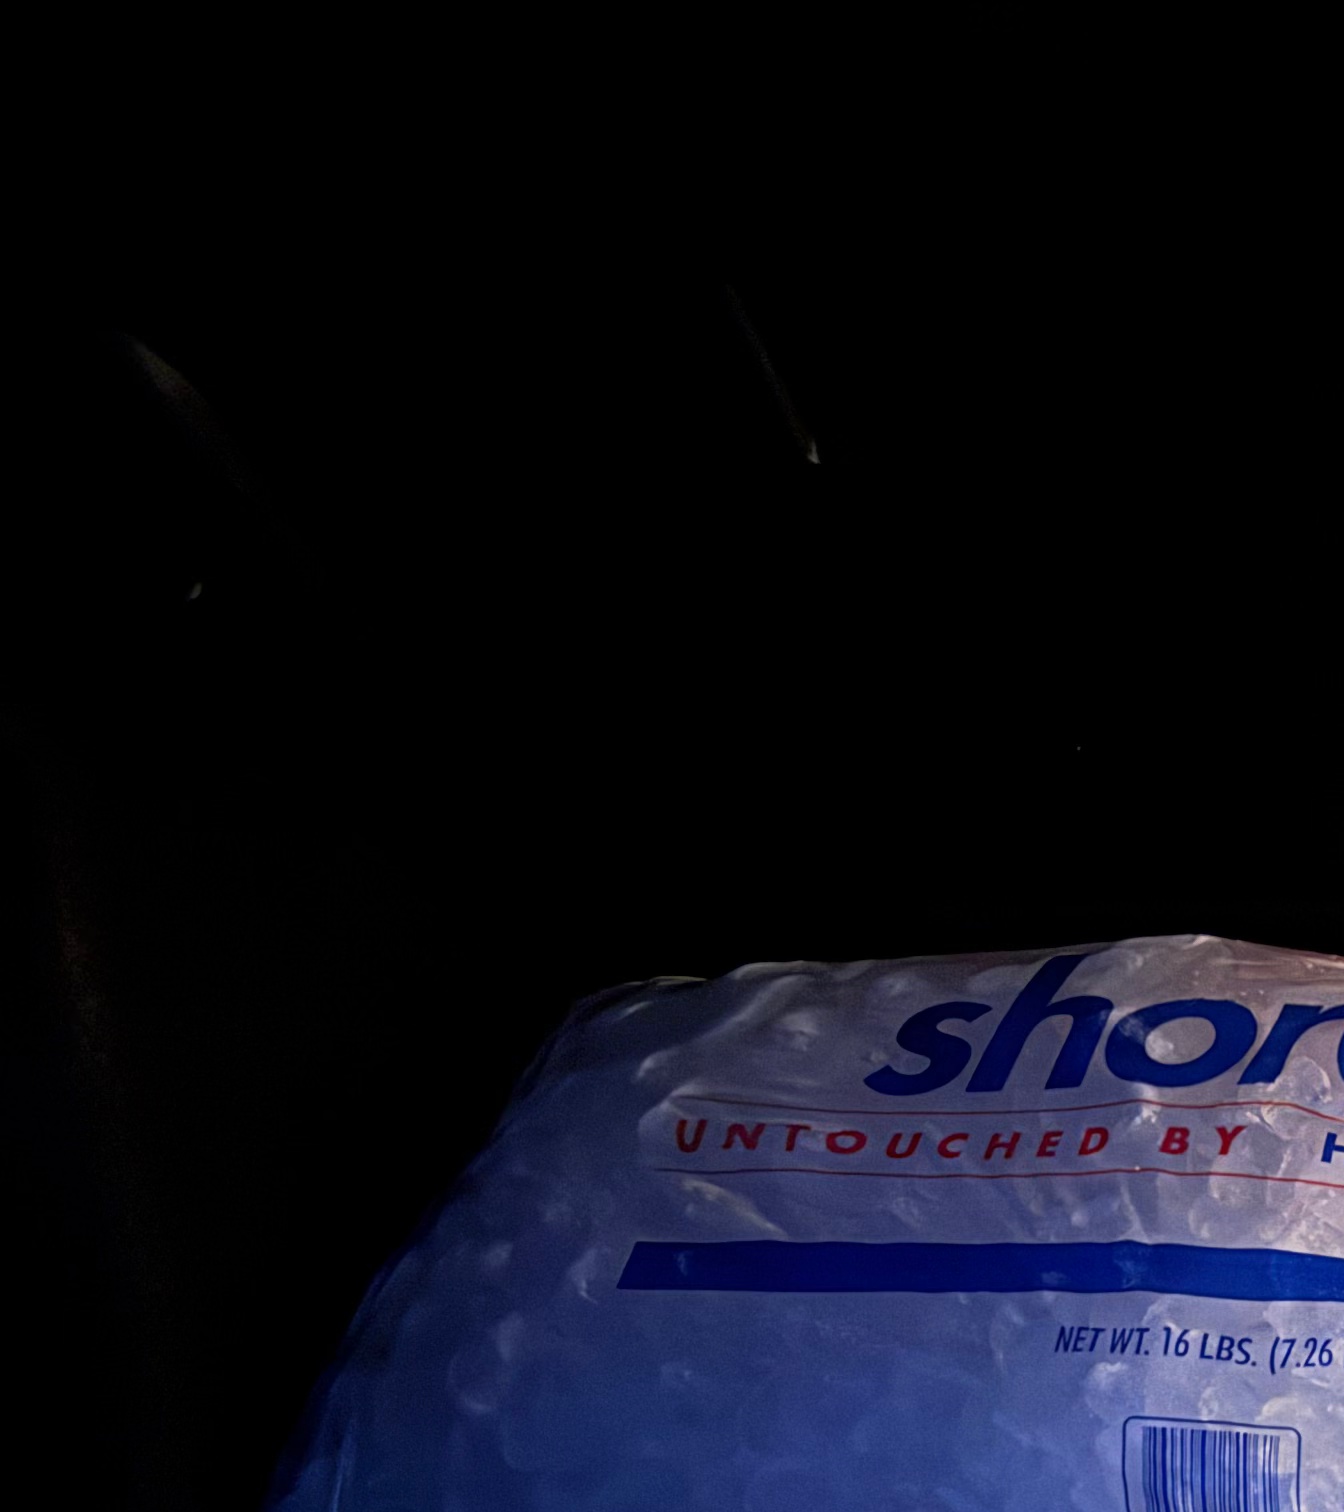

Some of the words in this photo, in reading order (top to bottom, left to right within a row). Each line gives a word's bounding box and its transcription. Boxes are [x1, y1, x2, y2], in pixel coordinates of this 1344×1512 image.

[674, 1118, 1109, 1160] UNTOUCHED
[1158, 1124, 1248, 1157] BY
[1055, 1325, 1105, 1354] NET
[1109, 1327, 1150, 1356] WT.
[1163, 1326, 1190, 1357] 16
[1199, 1333, 1258, 1367] LBS.
[1269, 1336, 1334, 1375] (7.26
